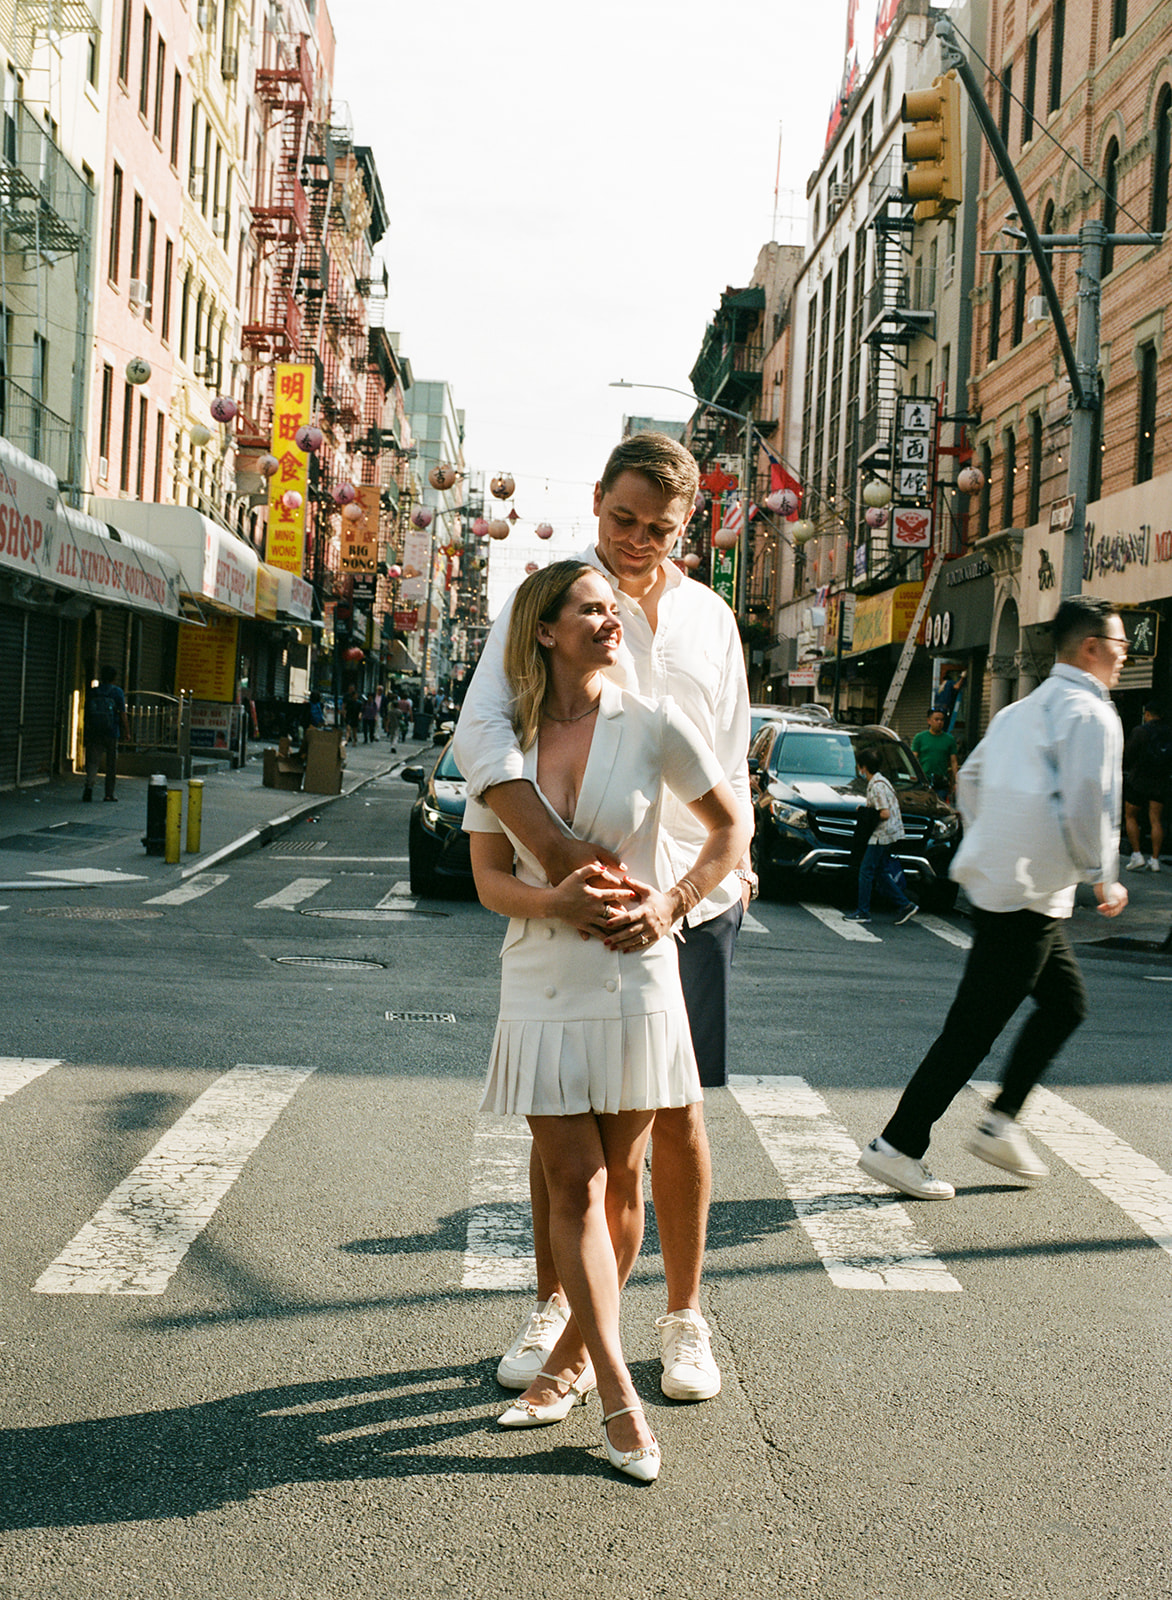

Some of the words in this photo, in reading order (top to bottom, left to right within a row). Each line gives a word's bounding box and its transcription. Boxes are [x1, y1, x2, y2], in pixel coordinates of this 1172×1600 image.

[0, 503, 43, 564] SHOP
[274, 529, 296, 542] MING
[271, 544, 297, 558] WONG
[349, 544, 368, 557] BIG
[56, 541, 77, 578] ALL
[80, 548, 110, 586] KINDS
[111, 559, 124, 590] OF
[341, 557, 375, 570] WONG
